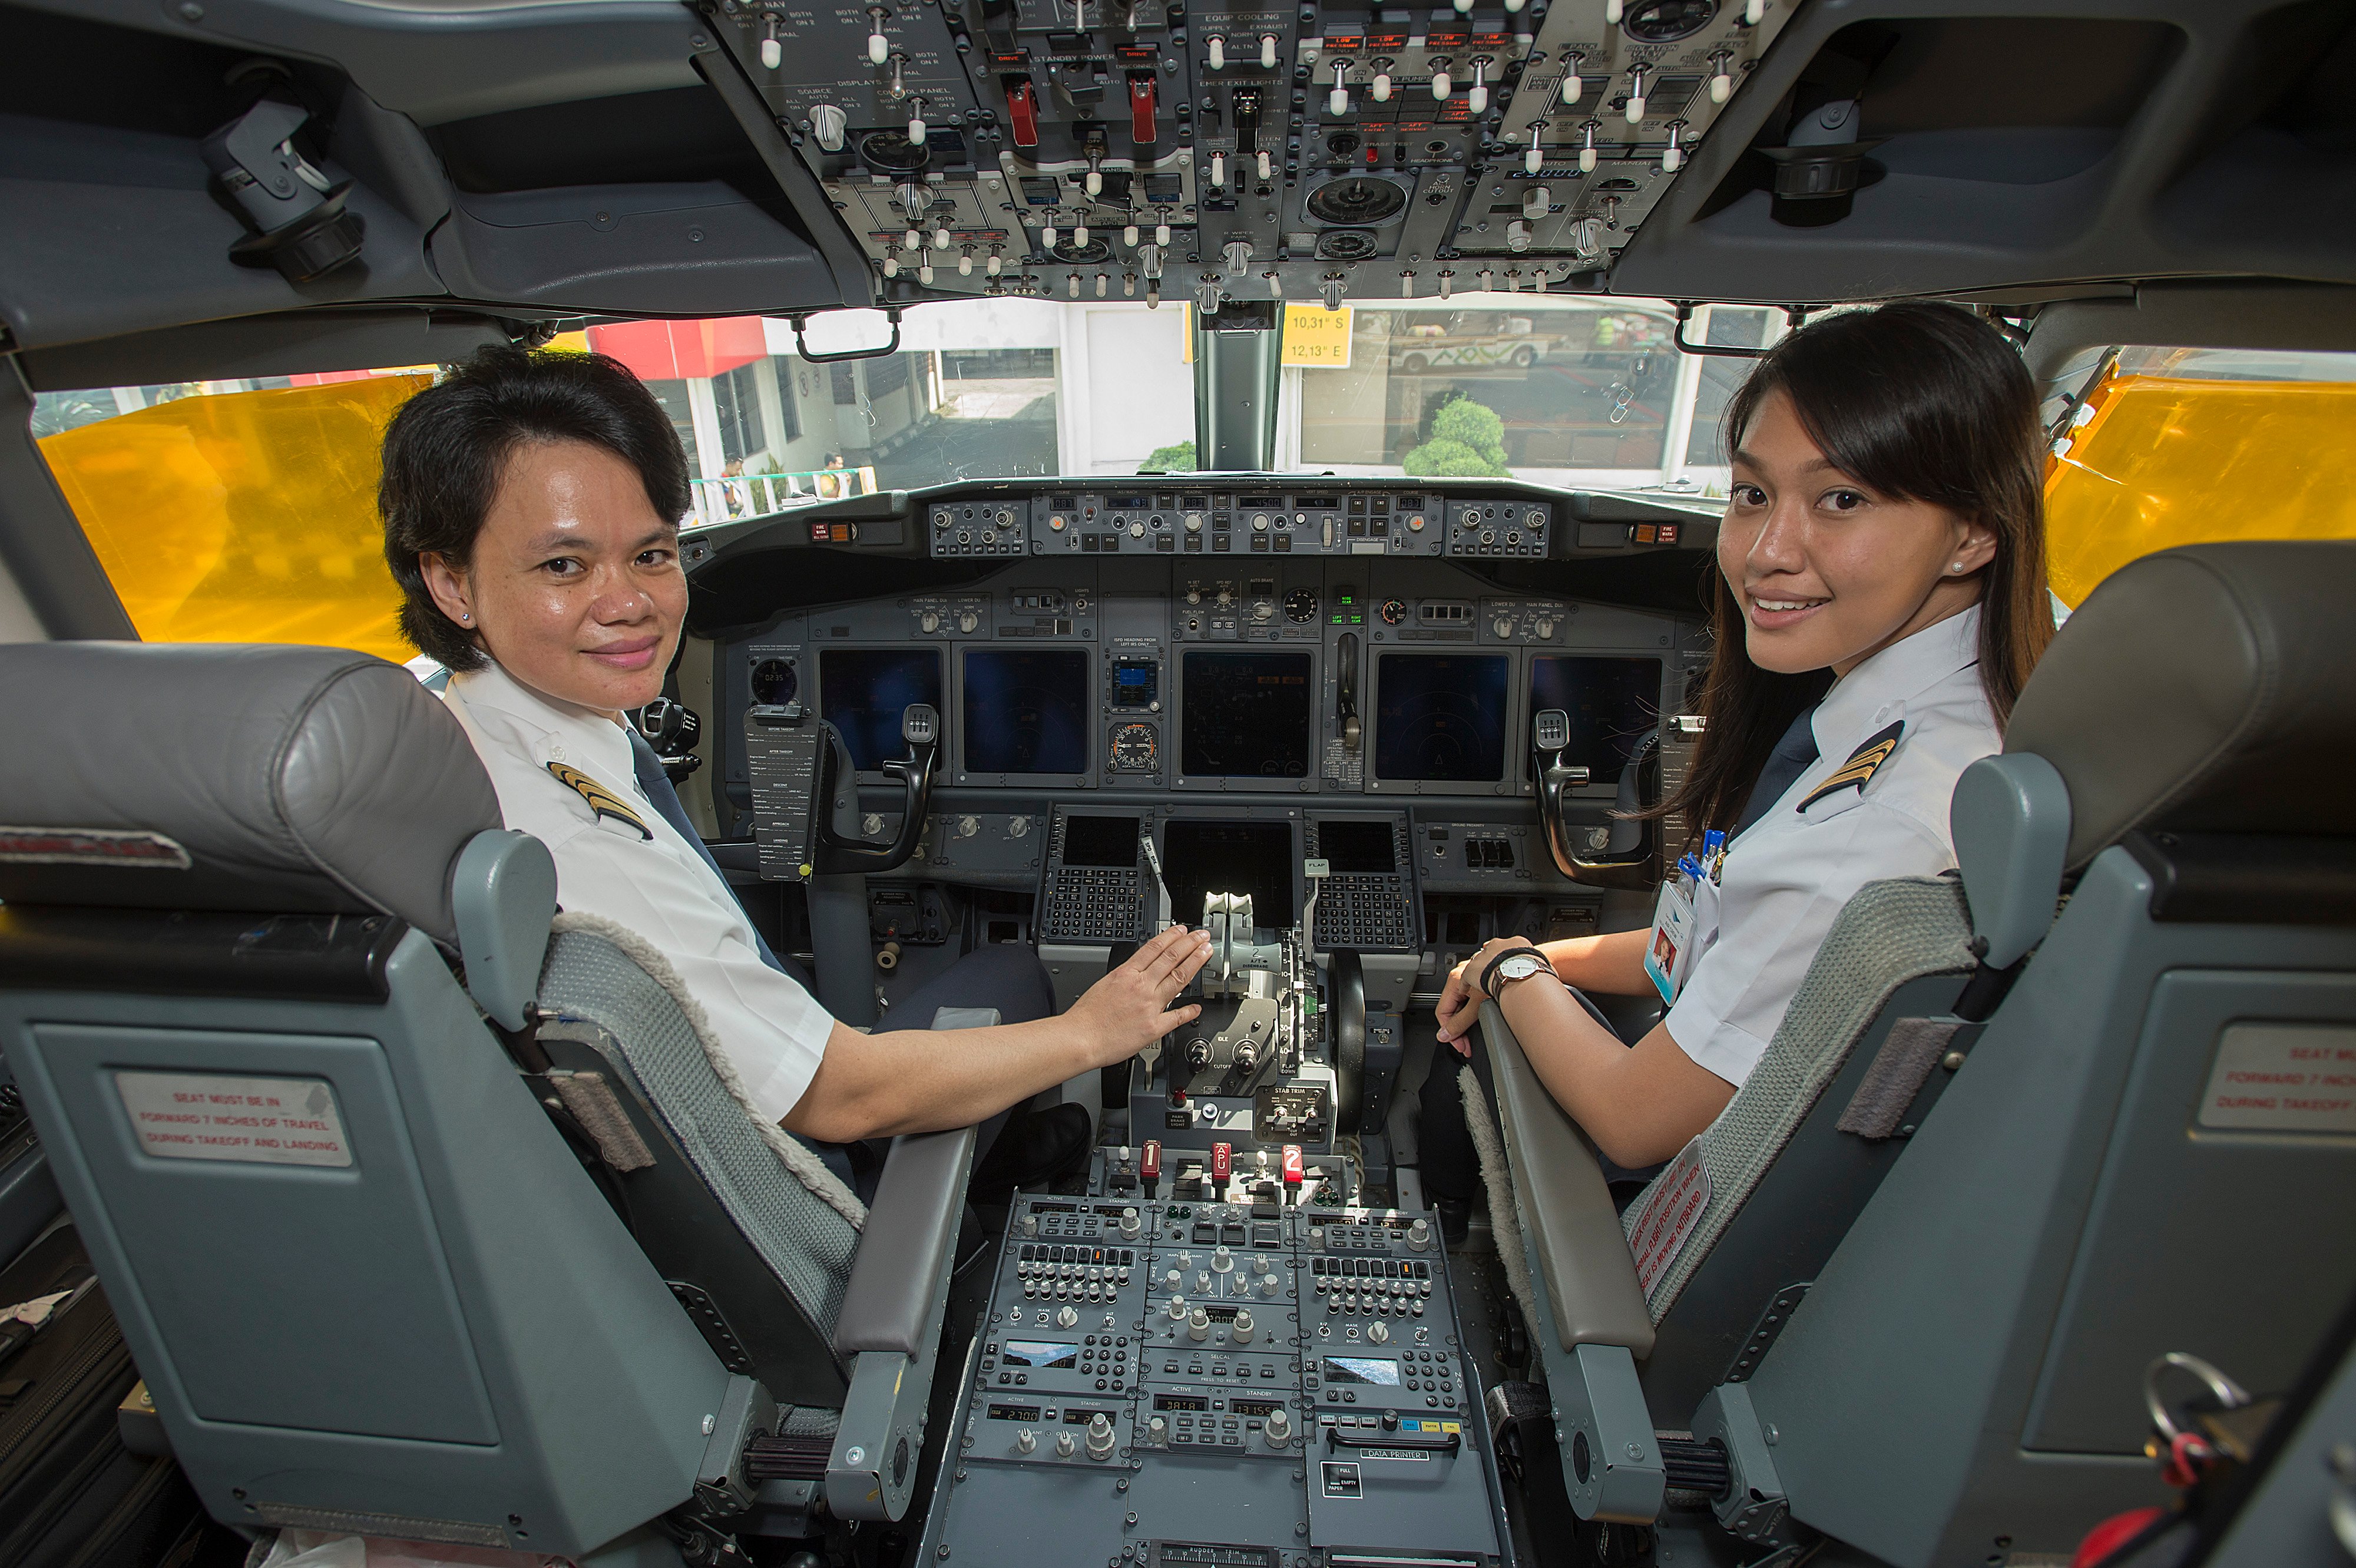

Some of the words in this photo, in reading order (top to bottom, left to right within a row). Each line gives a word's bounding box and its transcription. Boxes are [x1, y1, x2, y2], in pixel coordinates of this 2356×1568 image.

[1336, 317, 1344, 328] S
[1333, 346, 1341, 356] E
[1252, 948, 1259, 958] 2
[173, 1093, 205, 1103] SEAT
[209, 1094, 244, 1105] MUST
[247, 1096, 263, 1107] BE
[266, 1097, 280, 1107] IN
[139, 1112, 201, 1124] FORWARD
[213, 1115, 260, 1127] INCHES
[262, 1118, 277, 1127] OF
[283, 1119, 329, 1131] TRAVEL
[147, 1132, 194, 1144] DURING
[197, 1135, 250, 1146] TAKEOFF
[254, 1137, 280, 1148] AND
[283, 1140, 340, 1152] LANDING
[1147, 1144, 1154, 1166] 1
[1217, 1147, 1226, 1170] APU
[1285, 1150, 1301, 1172] 2
[1633, 1226, 1643, 1250] BACK
[1642, 1208, 1653, 1229] REST
[1653, 1188, 1668, 1210] MUST
[1669, 1170, 1677, 1187] BE
[1678, 1159, 1686, 1173] IN
[1636, 1248, 1651, 1275] ORMAL
[1649, 1222, 1663, 1253] FLIGHT
[1659, 1190, 1683, 1228] POSITION
[1682, 1163, 1700, 1194] WHEN
[1640, 1269, 1653, 1292] SEAT
[1652, 1261, 1657, 1275] IS
[1657, 1232, 1677, 1265] MOVING
[1676, 1190, 1701, 1236] OUTBOARD
[1455, 1372, 1463, 1388] NAV
[1167, 1401, 1195, 1410] DATA
